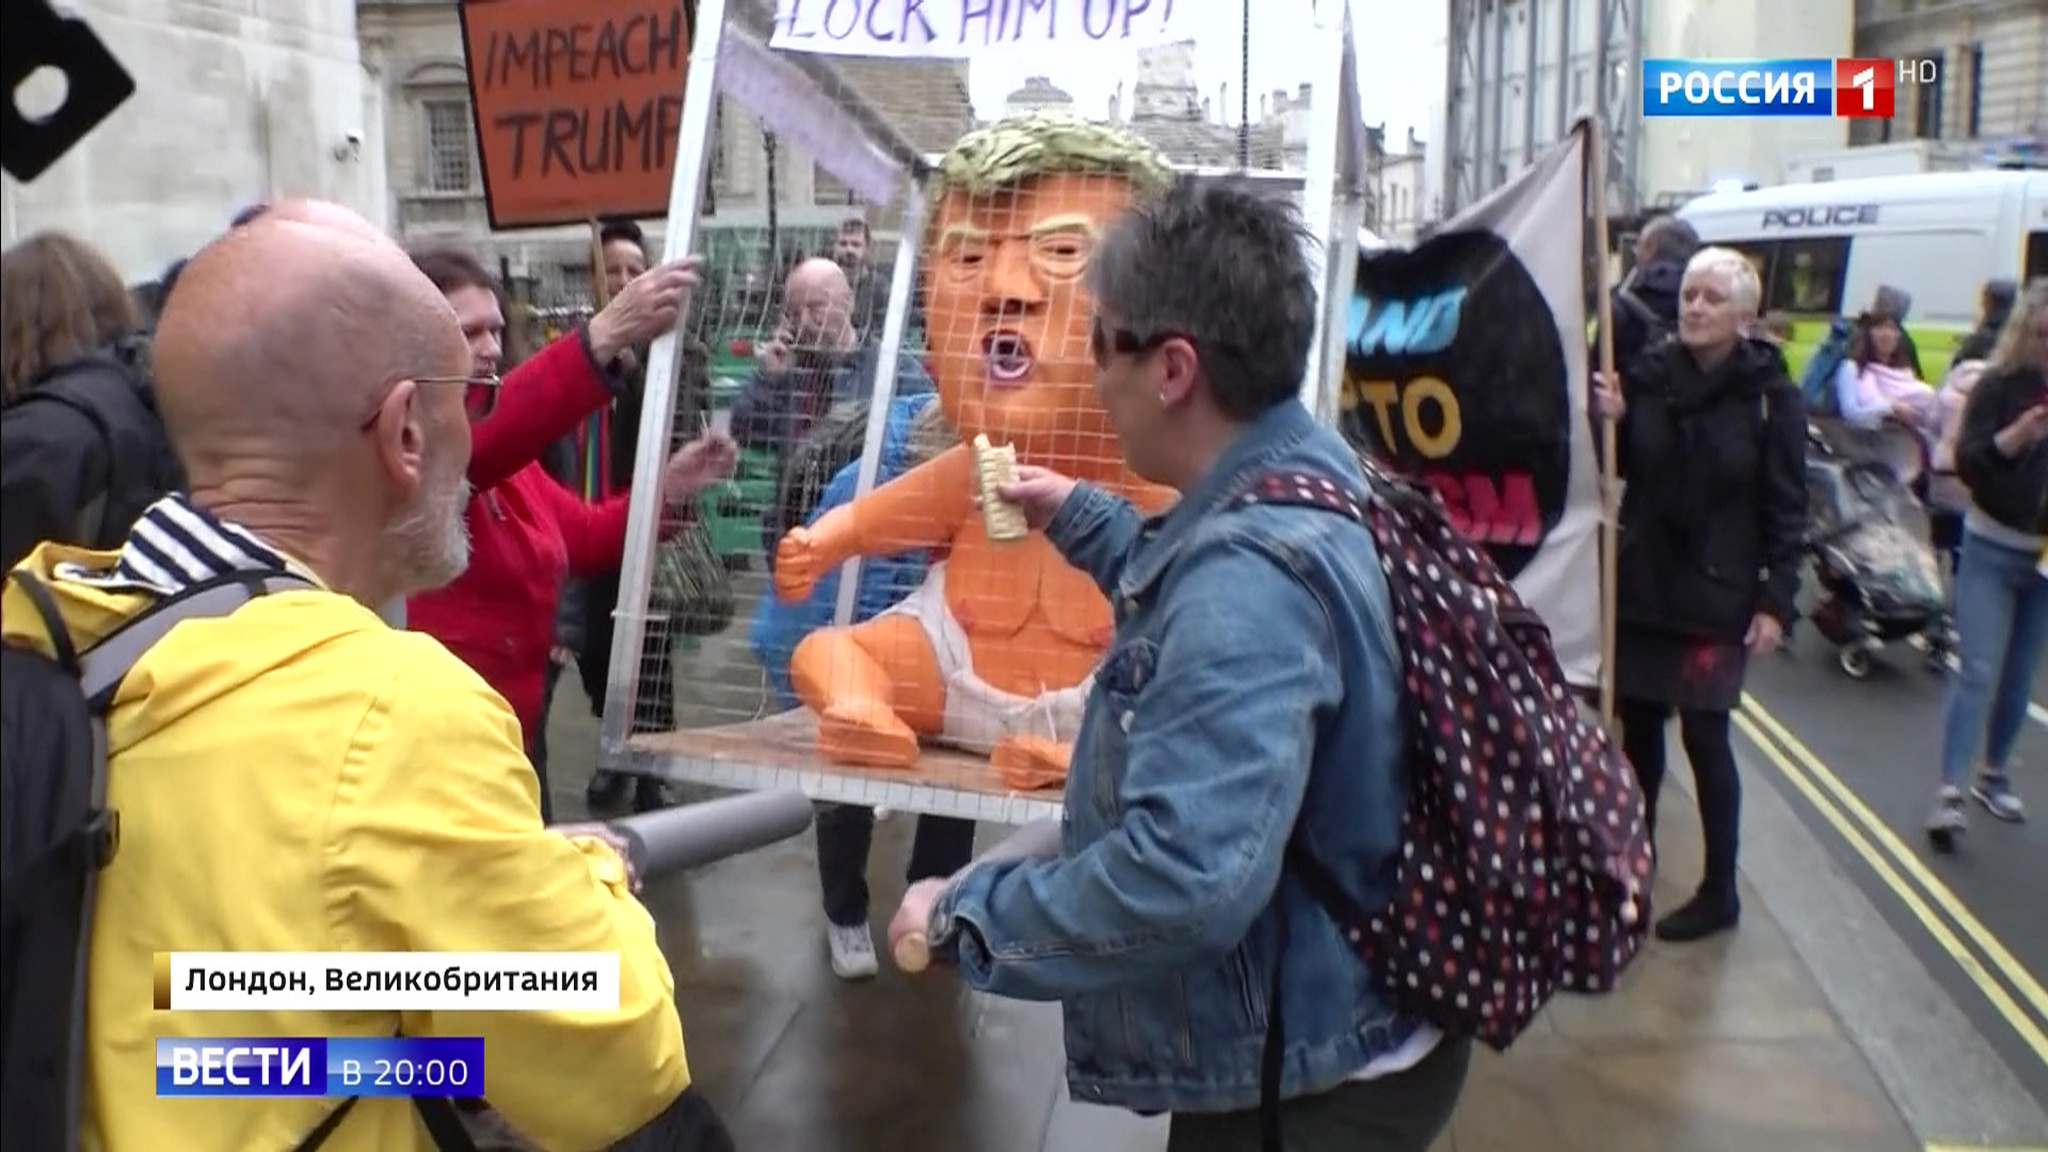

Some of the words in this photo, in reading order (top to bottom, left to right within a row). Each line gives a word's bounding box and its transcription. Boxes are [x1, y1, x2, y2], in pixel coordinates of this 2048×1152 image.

[484, 7, 682, 92] IMPEACH
[788, 0, 938, 43] LOCK
[959, 0, 1057, 45] HIM
[1082, 0, 1174, 40] UP!
[494, 94, 684, 181] TRUMP
[1762, 203, 1879, 230] POLICE
